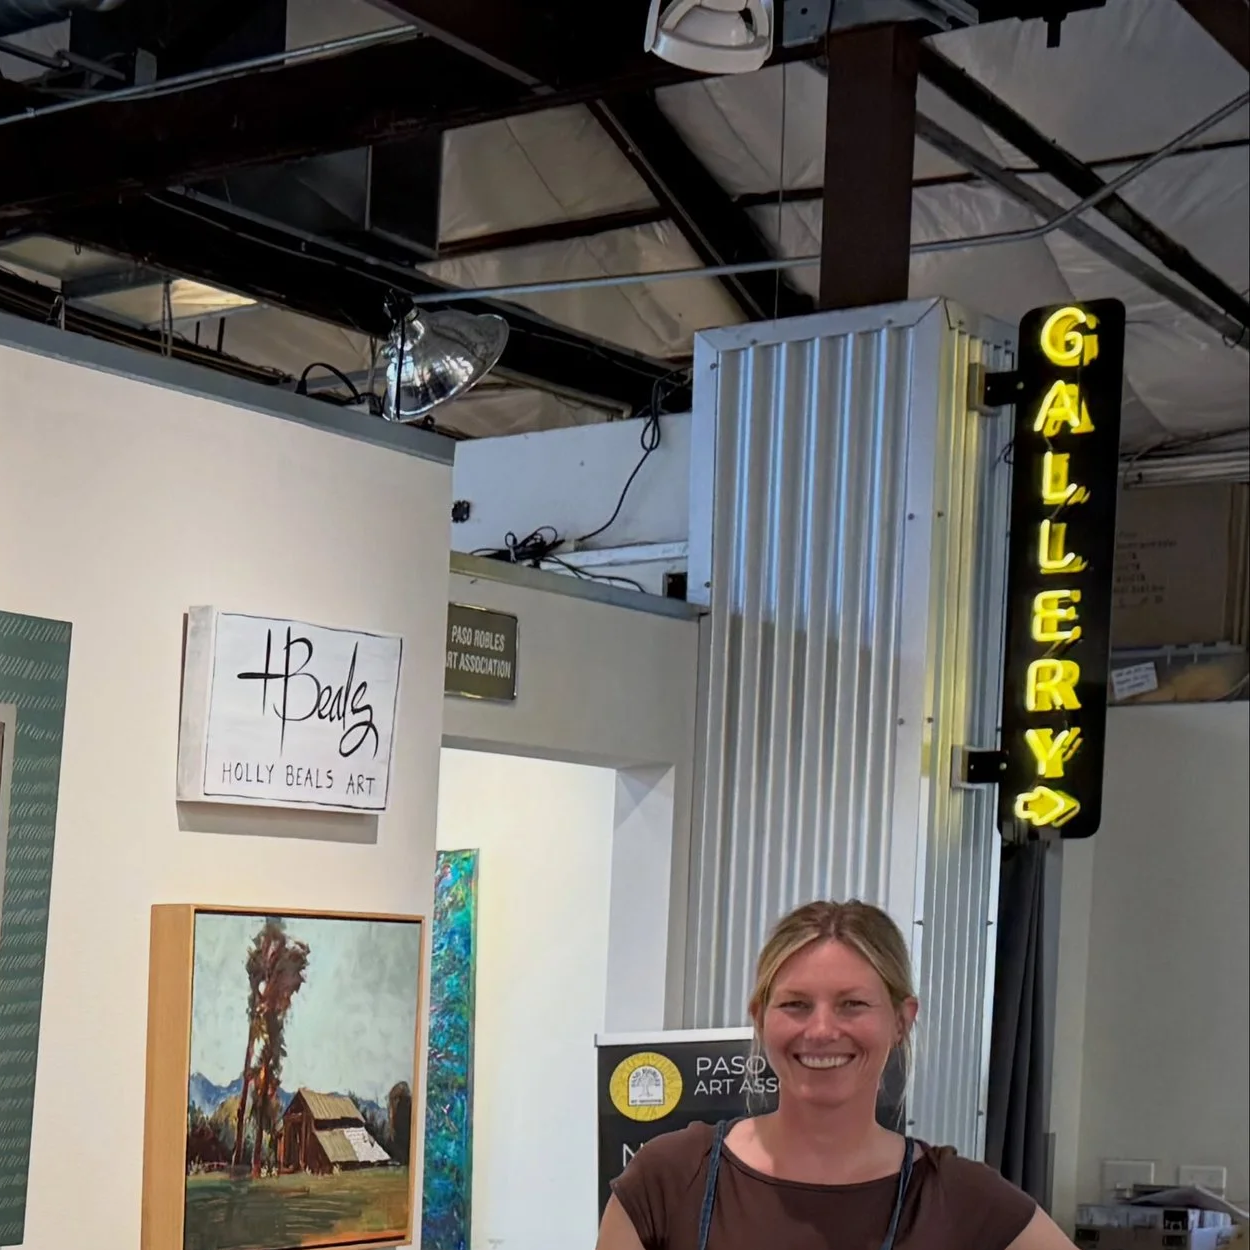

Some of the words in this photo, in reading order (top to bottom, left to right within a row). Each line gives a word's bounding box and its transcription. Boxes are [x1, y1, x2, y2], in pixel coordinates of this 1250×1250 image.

[1026, 306, 1099, 777] GALLERY
[452, 625, 472, 646] PASO
[473, 629, 505, 652] ROBLES
[459, 653, 511, 679] ASSOCIATION
[222, 762, 275, 784] HOLLY
[285, 764, 334, 789] BEALS
[346, 774, 376, 795] ART
[696, 1055, 766, 1077] PASO
[694, 1079, 734, 1096] ART
[738, 1077, 781, 1094] ASS
